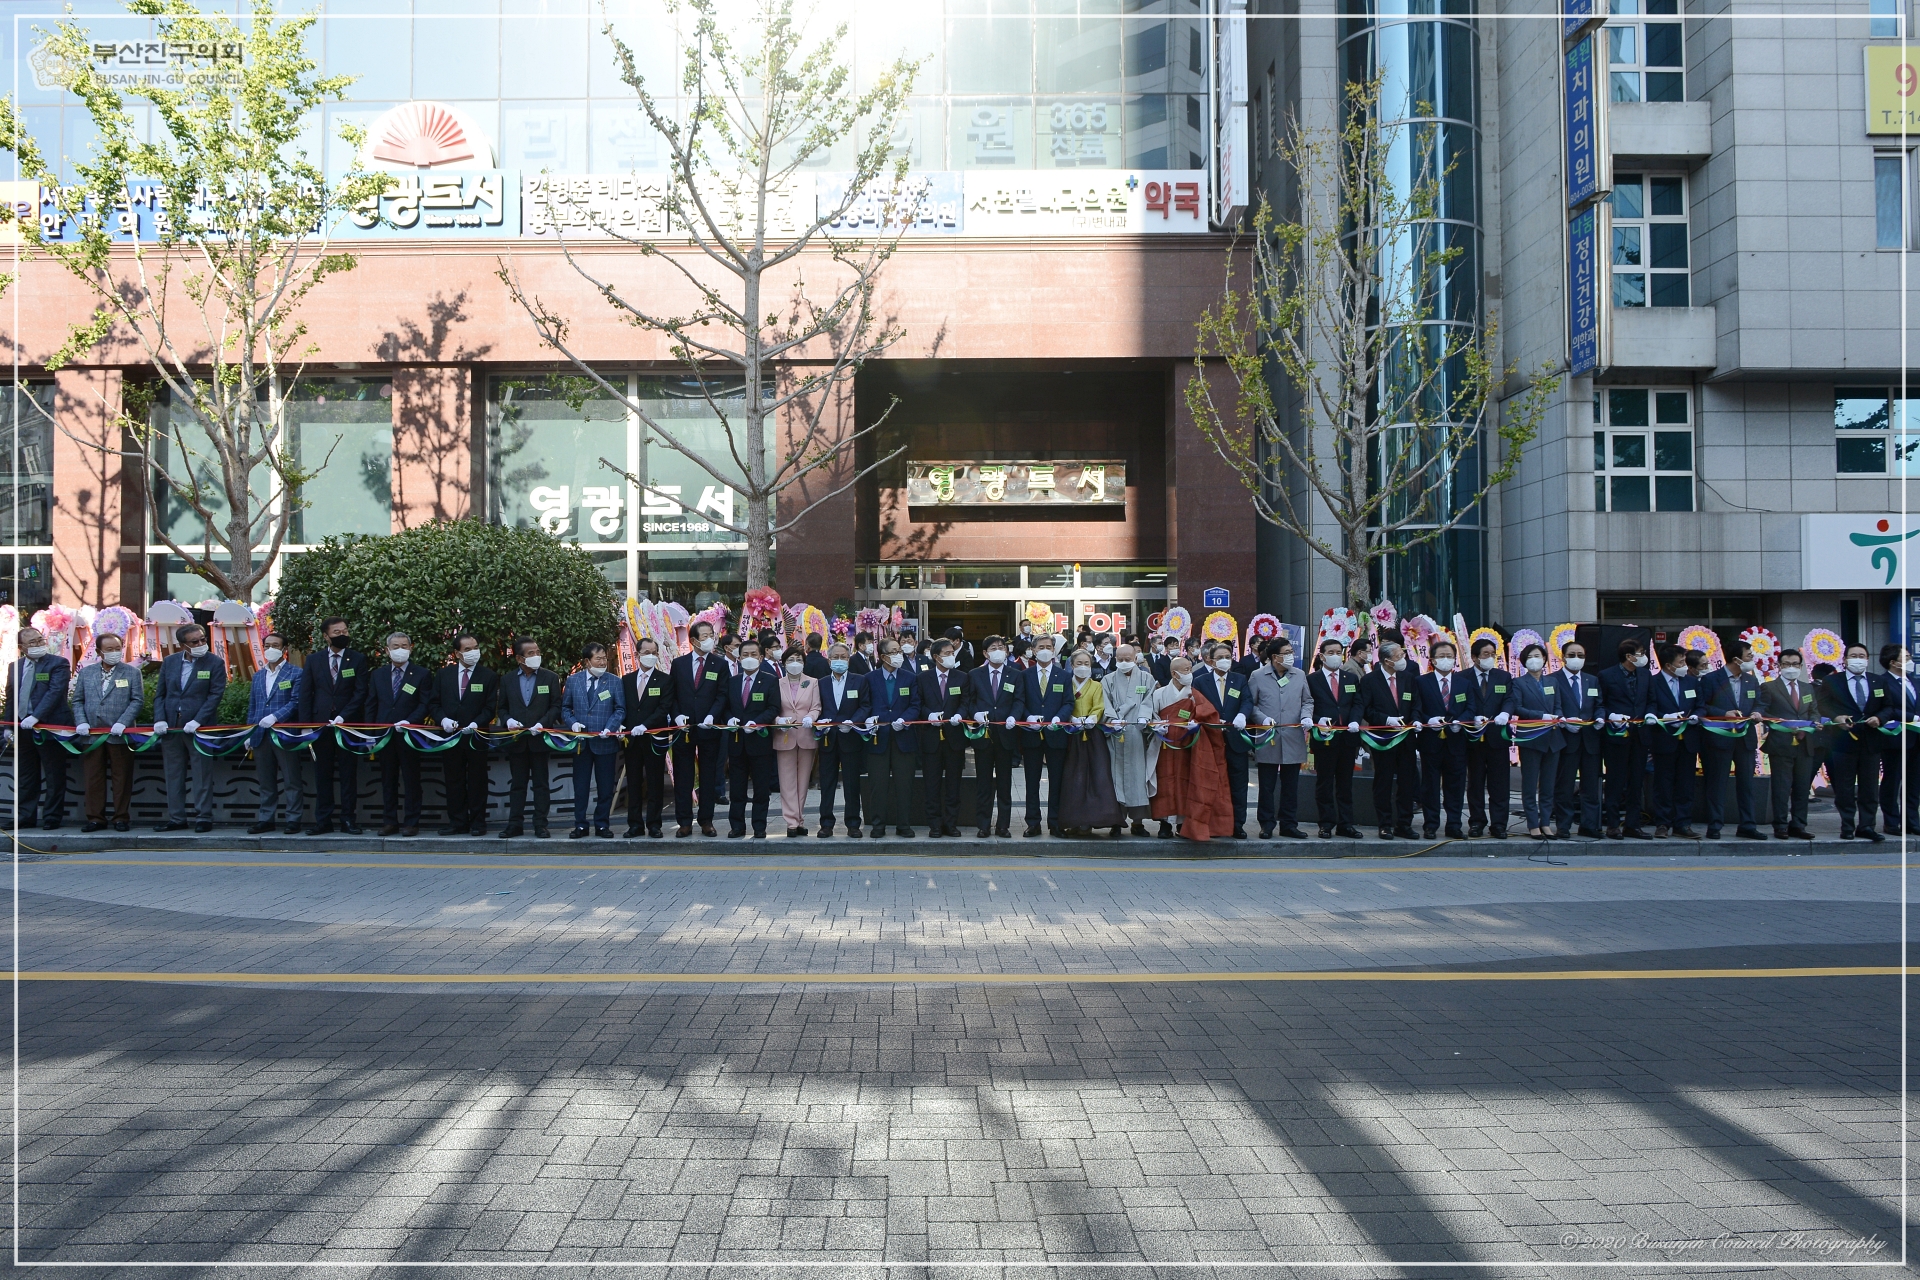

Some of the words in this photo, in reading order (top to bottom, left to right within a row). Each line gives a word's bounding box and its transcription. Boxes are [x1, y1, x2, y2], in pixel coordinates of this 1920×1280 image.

[1567, 40, 1591, 70] 목원
[1050, 102, 1107, 133] 365
[1571, 63, 1591, 184] 치과의원
[1050, 131, 1107, 166] 진료
[528, 177, 592, 204] 김병준
[597, 176, 662, 201] 레다스
[1144, 181, 1200, 219] 약국
[423, 214, 454, 227] Since
[528, 206, 614, 234] 흉부외과
[619, 206, 662, 233] 의원
[1071, 215, 1127, 229] (구)변내과
[1571, 214, 1594, 238] 나눔
[1575, 236, 1592, 329] 정신건강
[1572, 327, 1596, 350] 의학과
[1578, 347, 1591, 359] 의원
[928, 465, 1105, 501] 영광도서
[529, 485, 734, 536] 영광도서
[642, 522, 709, 533] SINCE1968
[1211, 597, 1222, 605] 10
